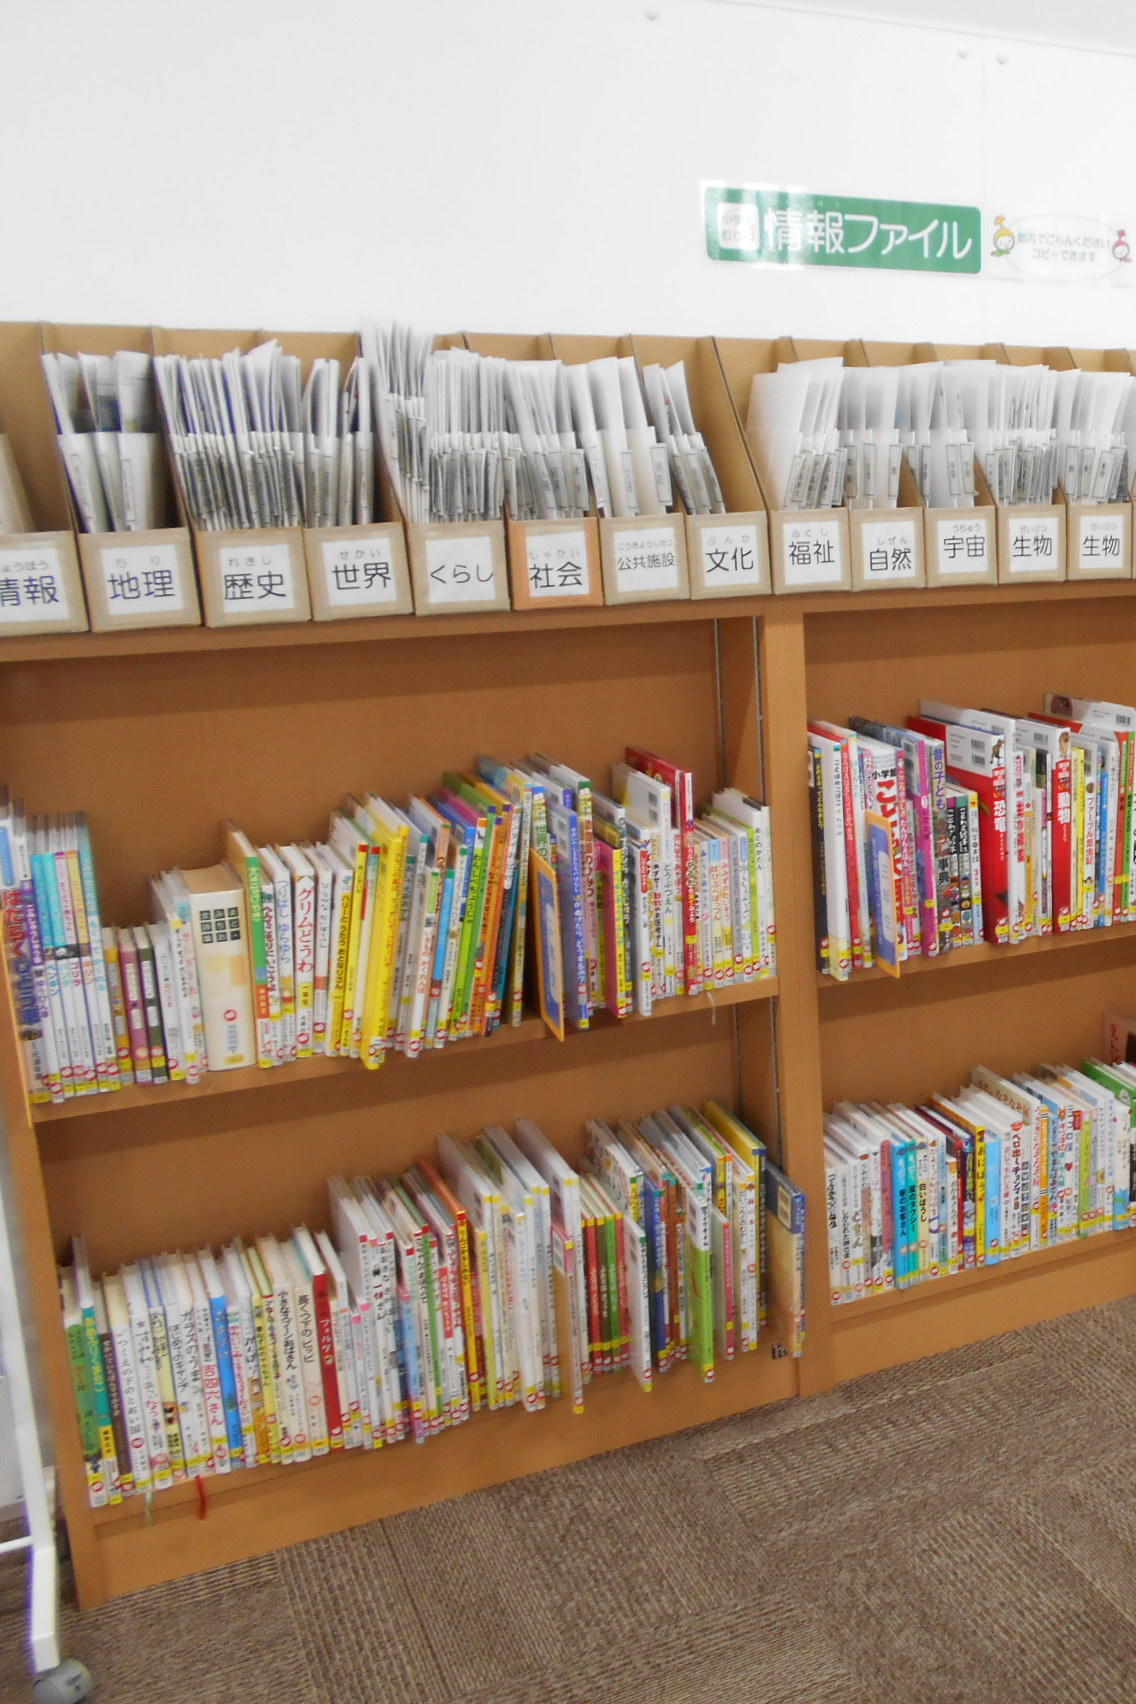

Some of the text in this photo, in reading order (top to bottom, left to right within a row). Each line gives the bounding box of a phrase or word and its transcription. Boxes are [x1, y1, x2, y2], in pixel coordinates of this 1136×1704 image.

[763, 206, 973, 259] 情報ファイル
[788, 540, 836, 566] 福祉
[943, 534, 986, 559] 宇宙
[1012, 534, 1053, 557] 生物
[1082, 534, 1121, 557] 生物
[617, 553, 675, 571] 公共施設
[704, 546, 755, 573] 文化
[869, 548, 913, 572] 自然
[107, 569, 176, 601] 地理
[223, 570, 287, 601] 歴史
[332, 562, 391, 591] 世界
[429, 563, 495, 585] くらし
[528, 561, 583, 590] 社会
[295, 888, 314, 973] グリムどうわ
